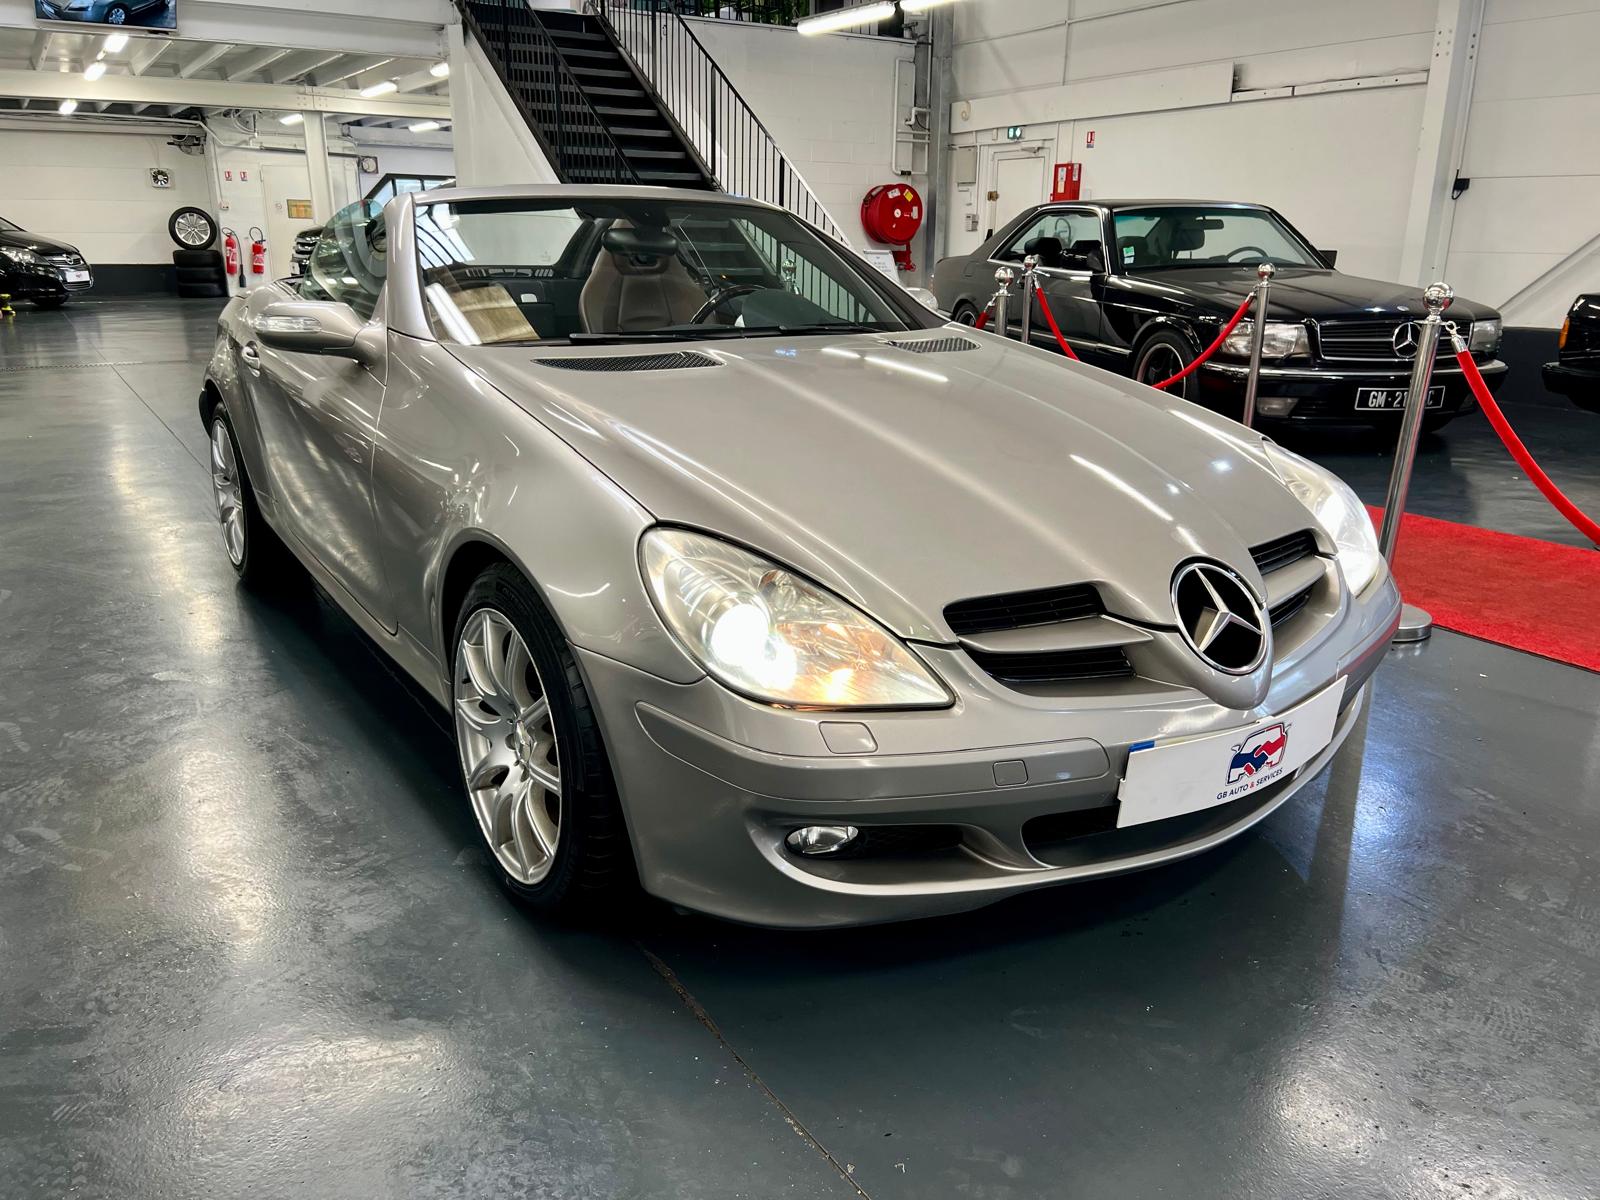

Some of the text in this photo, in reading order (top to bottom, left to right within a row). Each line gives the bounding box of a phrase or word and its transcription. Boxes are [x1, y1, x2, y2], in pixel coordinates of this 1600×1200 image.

[1216, 767, 1283, 800] GB AUTO & SERVICES
